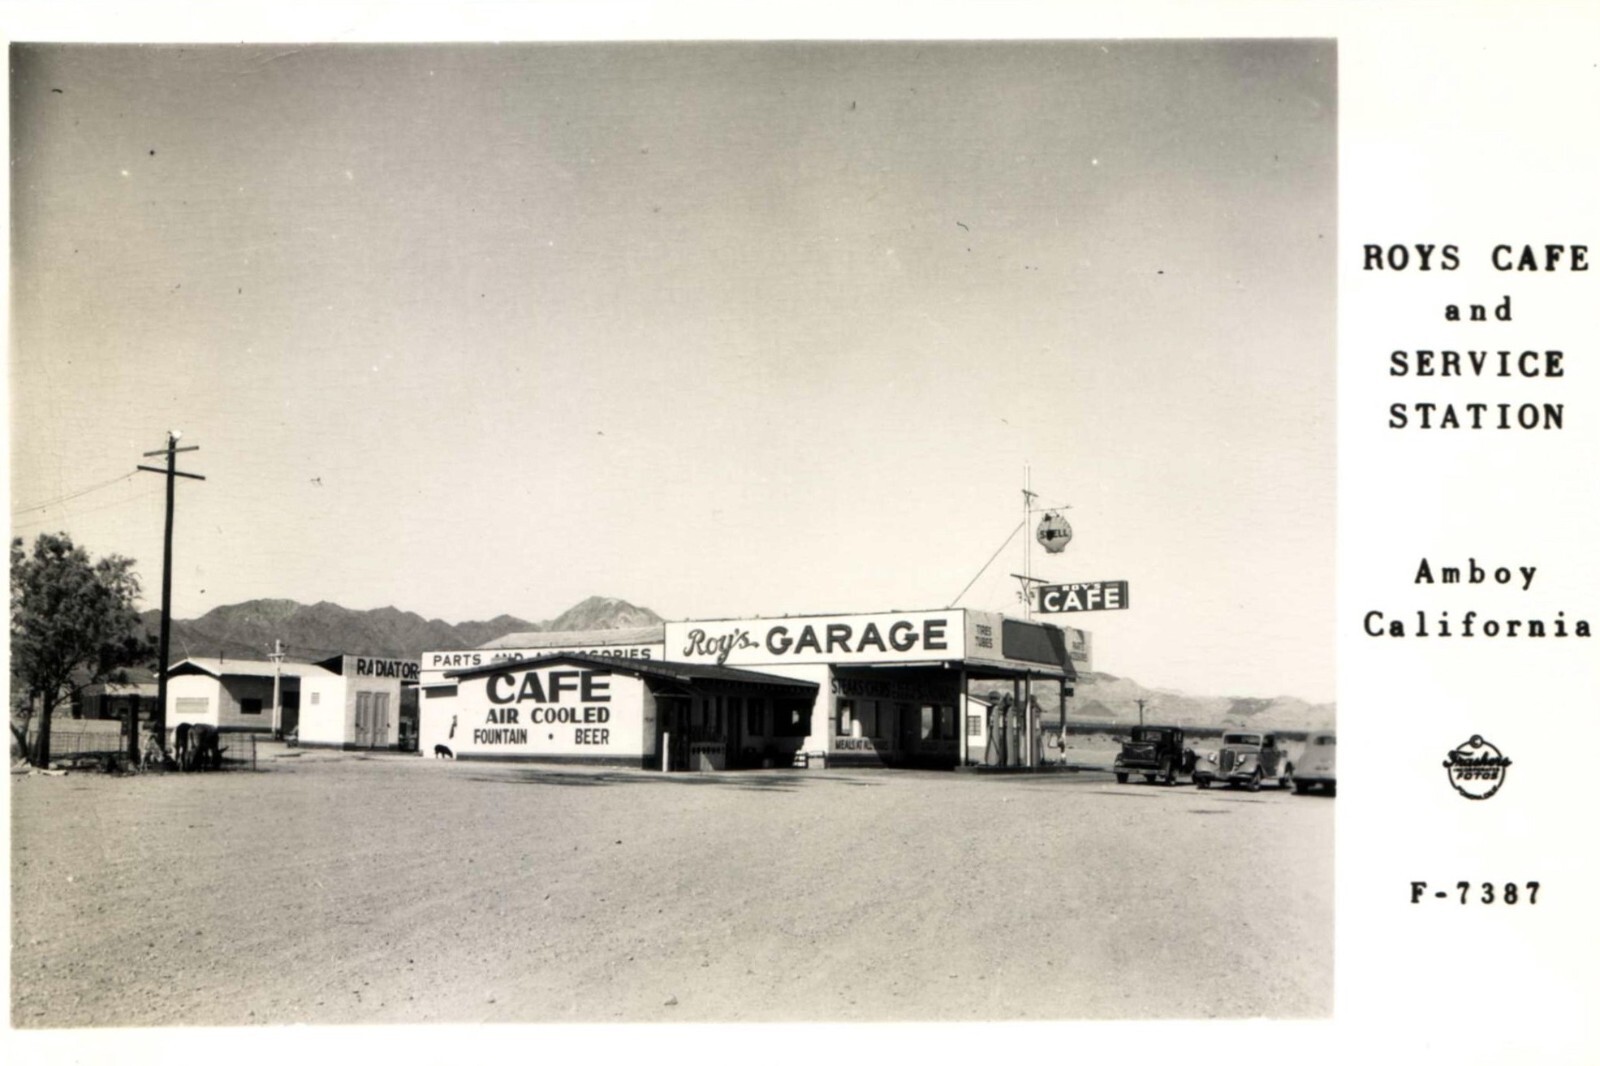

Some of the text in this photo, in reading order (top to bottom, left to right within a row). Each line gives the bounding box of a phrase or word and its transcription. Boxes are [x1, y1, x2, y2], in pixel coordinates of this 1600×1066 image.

[1040, 529, 1069, 540] SELL
[1044, 588, 1119, 611] CAFE
[683, 619, 948, 665] Roy's GARAGE
[433, 653, 482, 667] PARTS
[486, 671, 612, 704] CAFE
[485, 706, 611, 724] AIR COOLED
[473, 728, 610, 745] FOUNTAIN BEER
